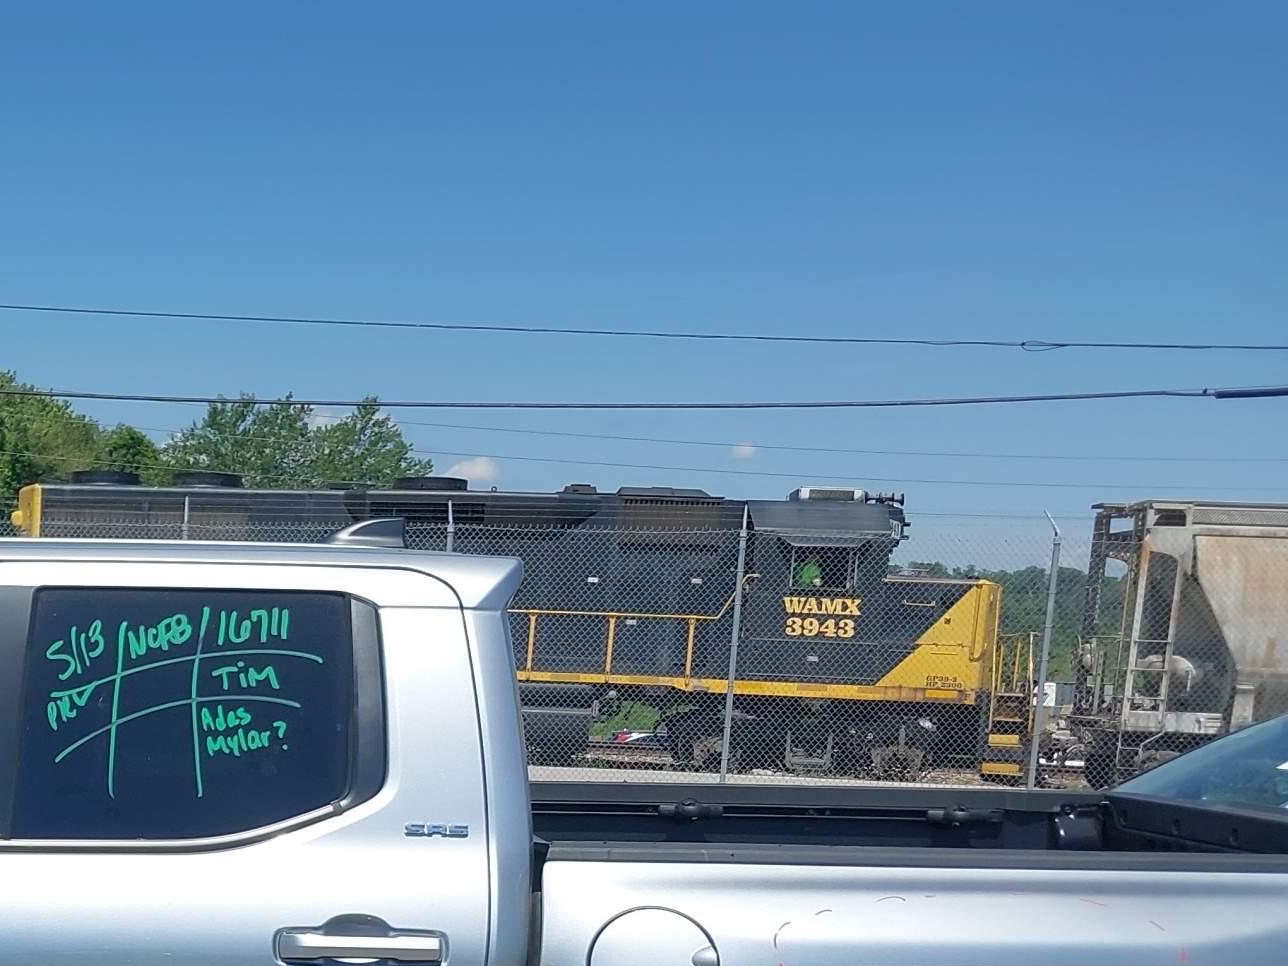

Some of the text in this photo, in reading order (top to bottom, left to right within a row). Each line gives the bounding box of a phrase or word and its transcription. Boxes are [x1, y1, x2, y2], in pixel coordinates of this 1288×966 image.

[783, 596, 861, 616] WAMX
[217, 607, 290, 645] 16711
[785, 617, 855, 638] 3943
